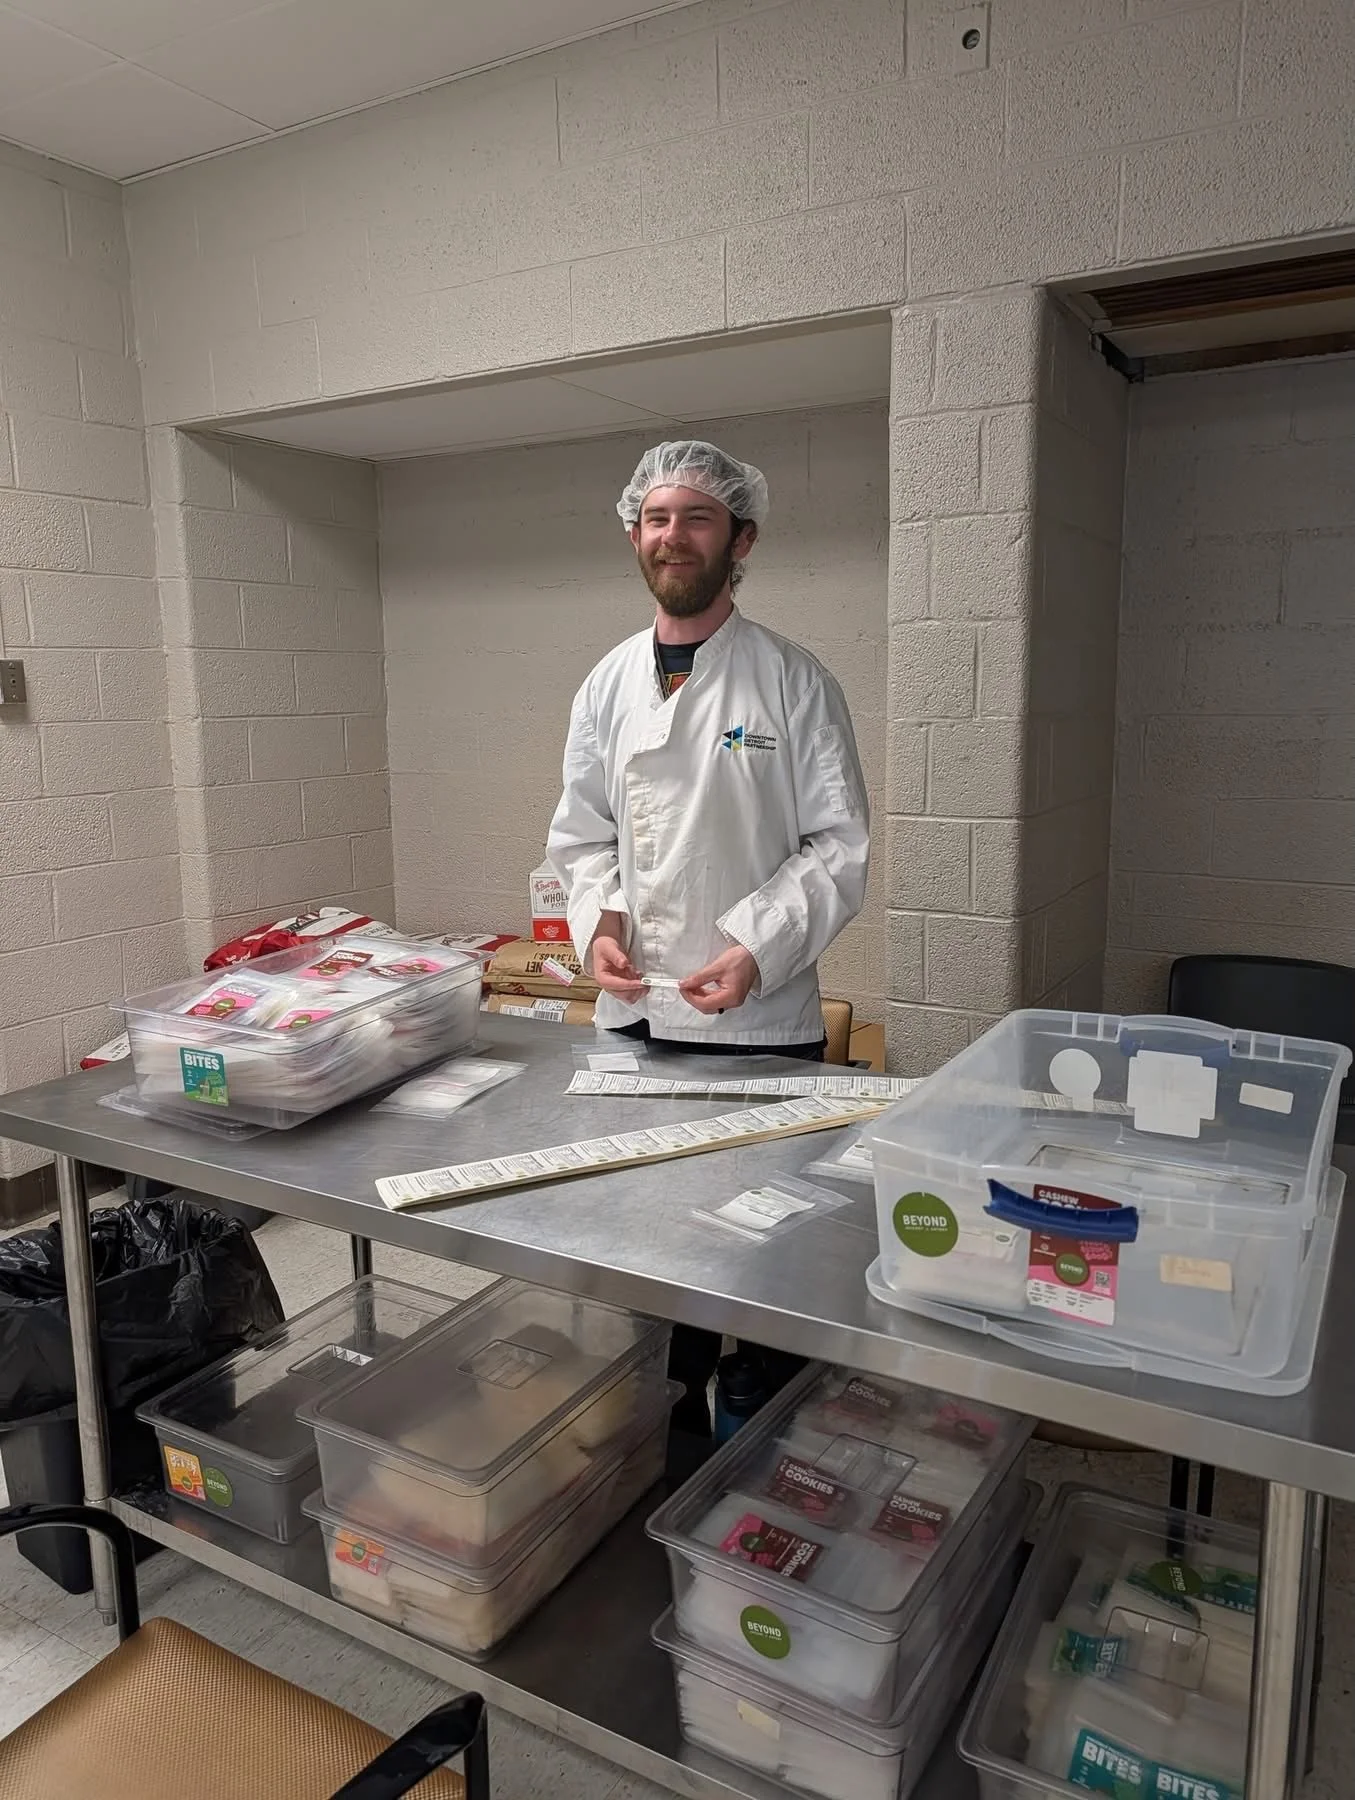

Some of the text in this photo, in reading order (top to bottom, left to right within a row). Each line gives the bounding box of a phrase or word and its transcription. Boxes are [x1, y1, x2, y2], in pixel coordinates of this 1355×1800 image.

[525, 961, 544, 973] NET
[184, 1053, 220, 1070] BITES
[1038, 1189, 1080, 1205] CASHEW
[902, 1214, 948, 1227] BEYOND
[206, 1478, 229, 1491] BEYOND
[785, 1470, 835, 1495] COOKIES
[889, 1500, 944, 1521] COOKIES
[747, 1621, 782, 1637] BEYOND
[1081, 1740, 1143, 1785] BITES
[1156, 1771, 1221, 1800] BITES
